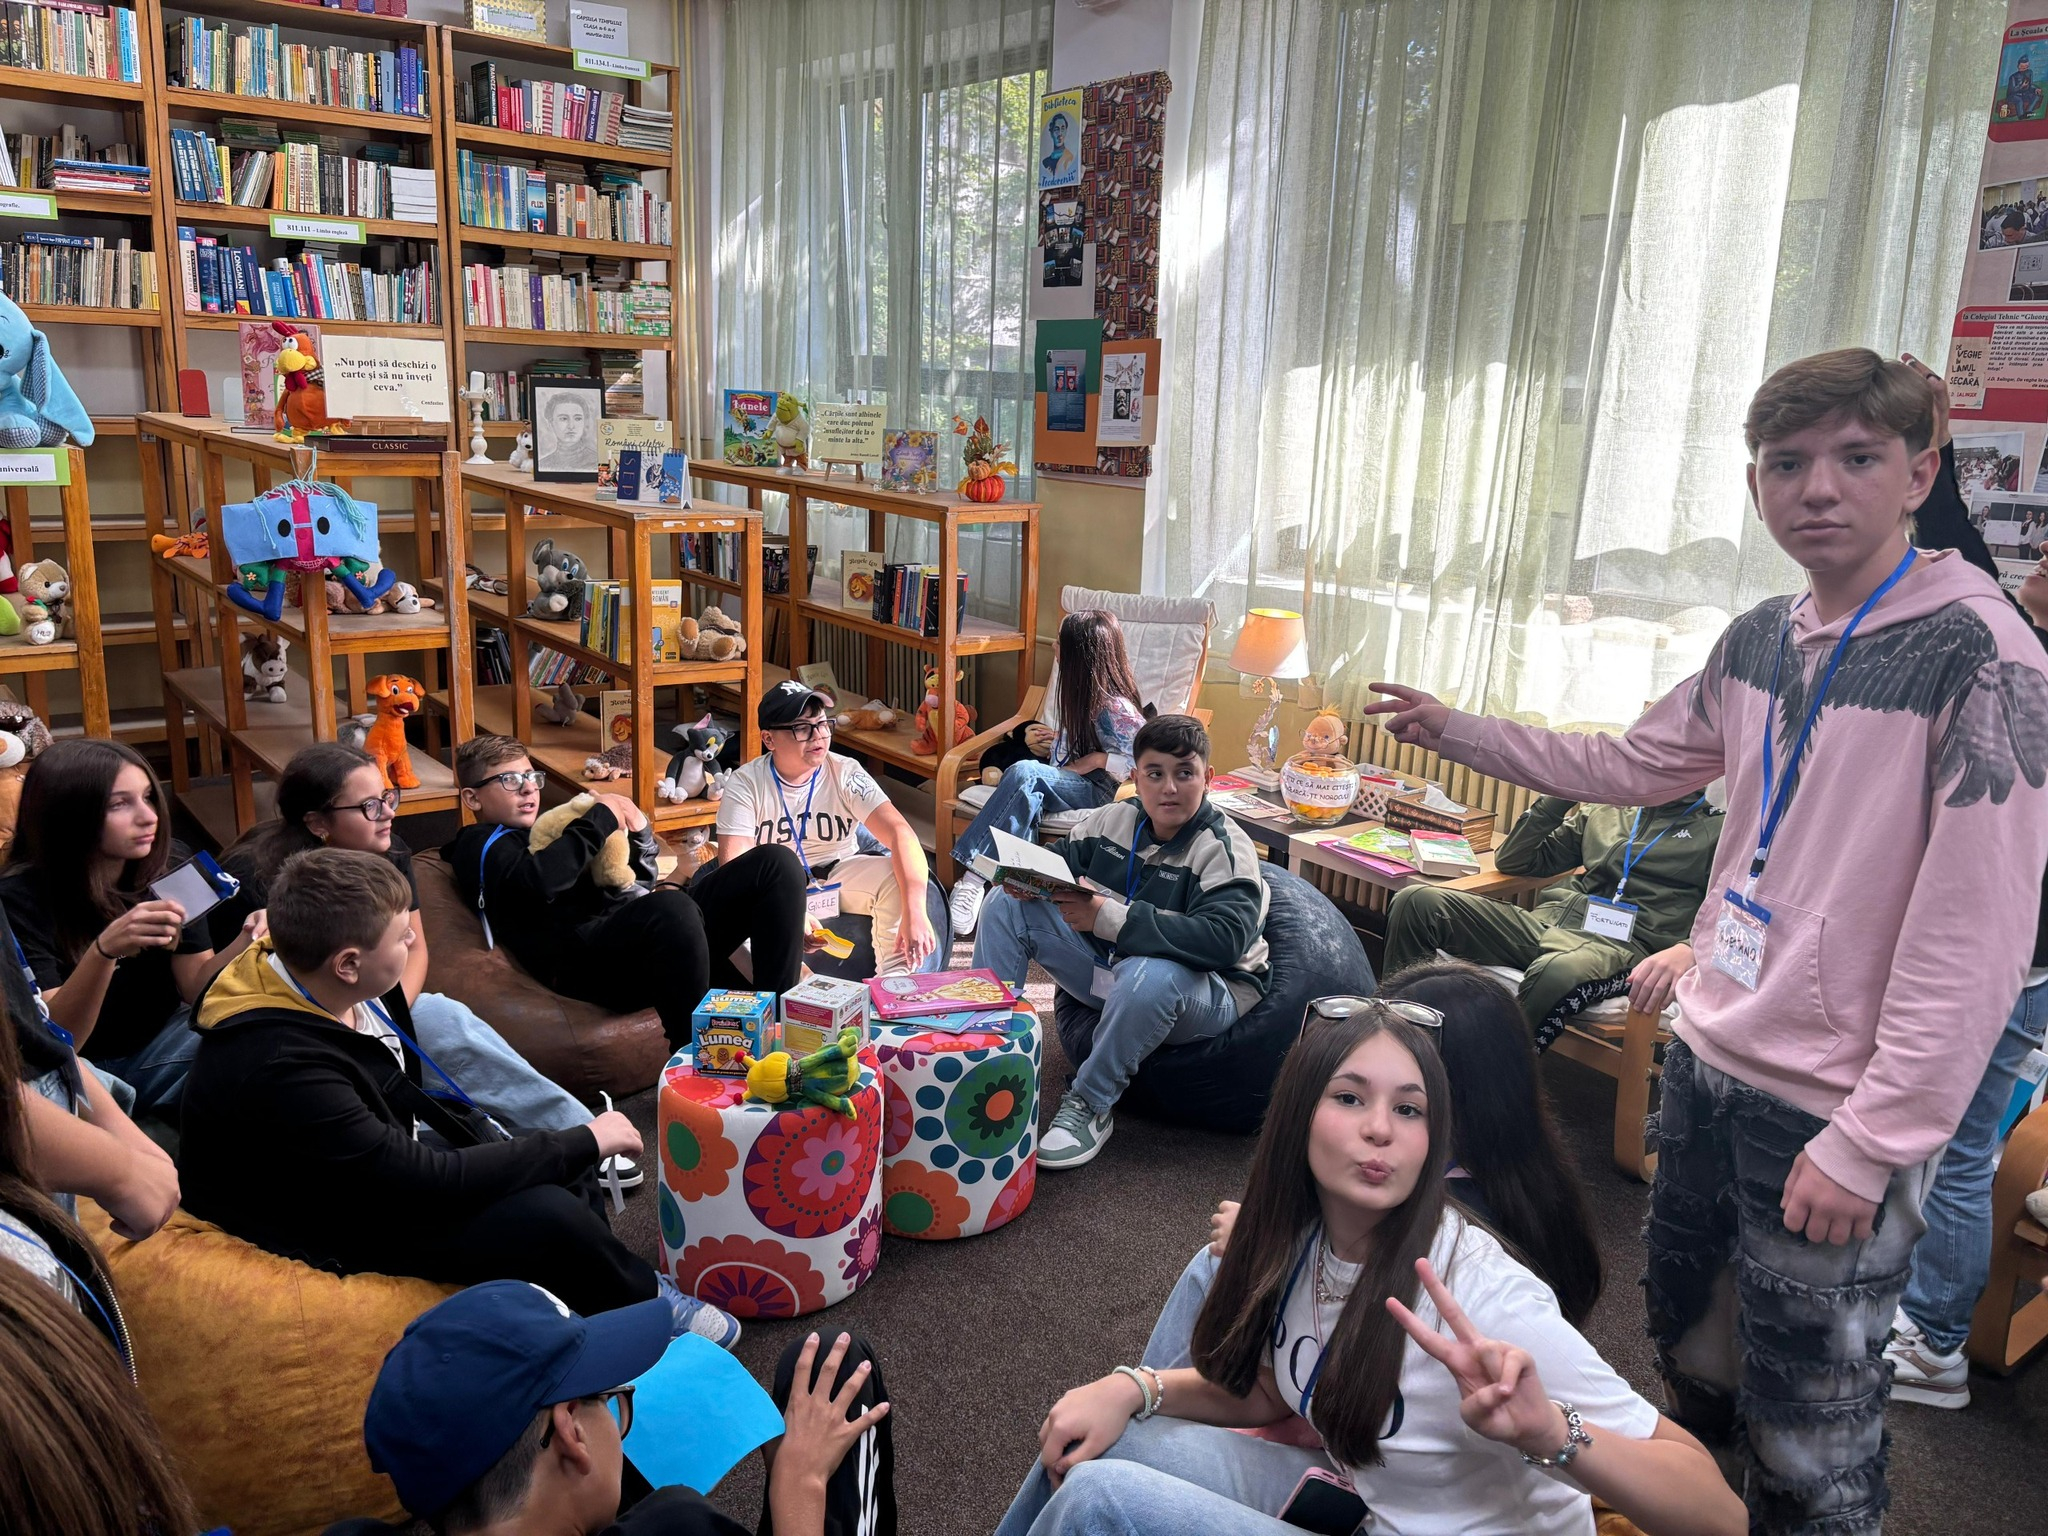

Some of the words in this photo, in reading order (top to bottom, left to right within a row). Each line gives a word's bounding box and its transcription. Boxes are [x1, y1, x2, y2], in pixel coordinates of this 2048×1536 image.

[1044, 96, 1077, 112] Biblioteca
[0, 201, 20, 209] ografie.
[234, 251, 245, 290] LONGMAN
[1970, 313, 1997, 321] Colegiul
[1957, 350, 1982, 359] VEGHE
[334, 357, 355, 367] „Nu
[357, 359, 376, 369] poți
[379, 359, 389, 368] să
[391, 360, 429, 370] deschizi
[1952, 364, 1976, 373] LANUL
[341, 371, 366, 379] carte
[368, 371, 376, 381] și
[378, 371, 389, 379] să
[406, 372, 432, 383] înveți
[1950, 376, 1980, 386] SECARĂ
[605, 438, 637, 448] Români
[638, 439, 666, 448] celebri
[754, 812, 853, 846] OSTON
[1590, 912, 1628, 928] FORTUNATO
[698, 1034, 753, 1049] Lumea
